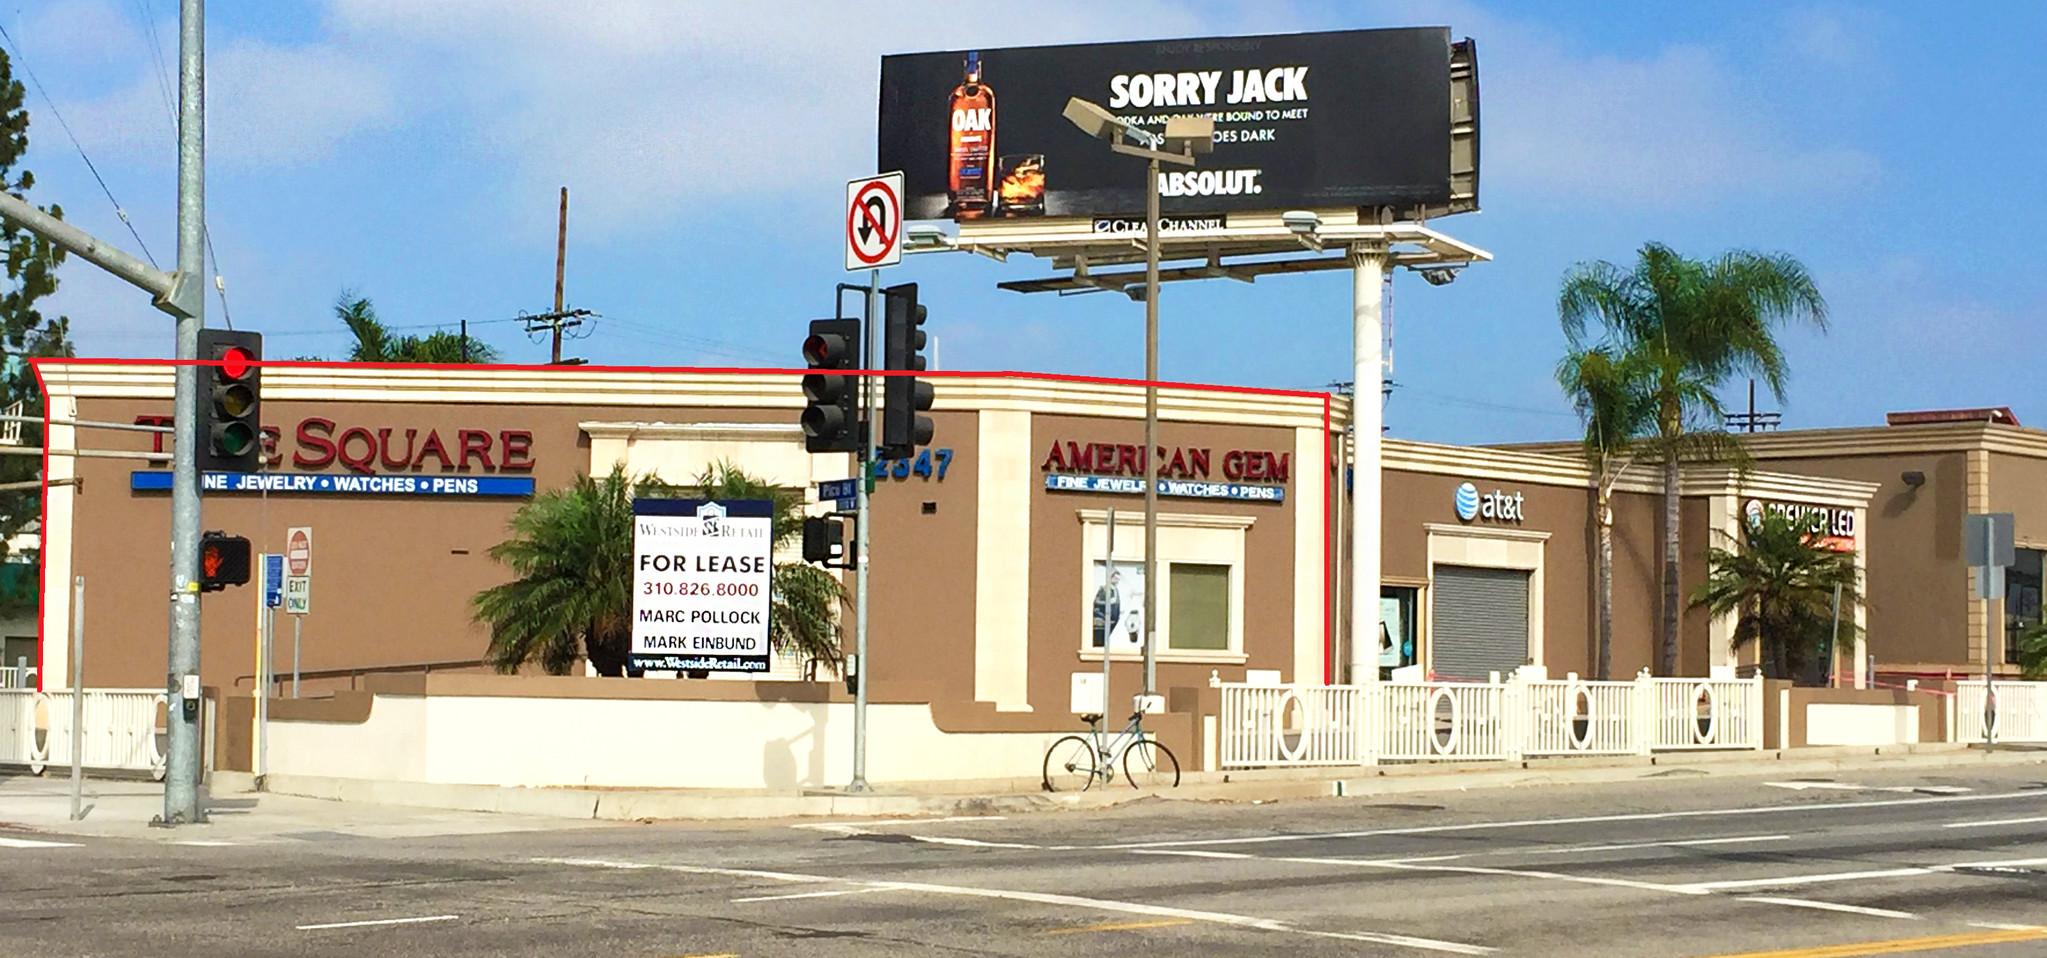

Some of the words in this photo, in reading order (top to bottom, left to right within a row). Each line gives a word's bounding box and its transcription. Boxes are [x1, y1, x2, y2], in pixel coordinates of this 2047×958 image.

[1110, 71, 1222, 108] SORRY
[1227, 66, 1309, 103] JACK
[952, 108, 992, 131] OAK
[1116, 115, 1145, 126] ODKA
[1147, 114, 1168, 125] AND
[1226, 110, 1263, 122] BOUND
[1266, 110, 1280, 120] TO
[1281, 108, 1309, 120] MEET
[1212, 129, 1238, 143] OES
[1240, 128, 1276, 142] DARK
[1112, 219, 1148, 232] CLEA
[1157, 218, 1224, 232] CHANNEL
[134, 415, 283, 466] TE
[292, 417, 537, 475] SQUARE
[1223, 449, 1290, 482] GEM
[201, 474, 228, 489] INE
[236, 475, 317, 490] JEWELRY
[333, 477, 416, 492] WATCHES
[433, 479, 478, 493] PENS
[1057, 476, 1089, 488] FINE
[1094, 479, 1147, 491] JEWELR
[1168, 484, 1229, 496] WATCHES
[1240, 487, 1275, 499] PENS
[1482, 489, 1524, 520] at&t
[1831, 509, 1856, 537] LED
[640, 554, 686, 572] FOR
[696, 556, 765, 573] LEASE
[289, 580, 307, 593] EXIT
[643, 582, 759, 597] 310.826.8000
[639, 609, 685, 623] MARC
[691, 610, 761, 624] POLLOCK
[643, 636, 687, 649] MARK
[693, 636, 756, 650] EINBUND
[633, 656, 766, 670] www.WestsideRetail.com
